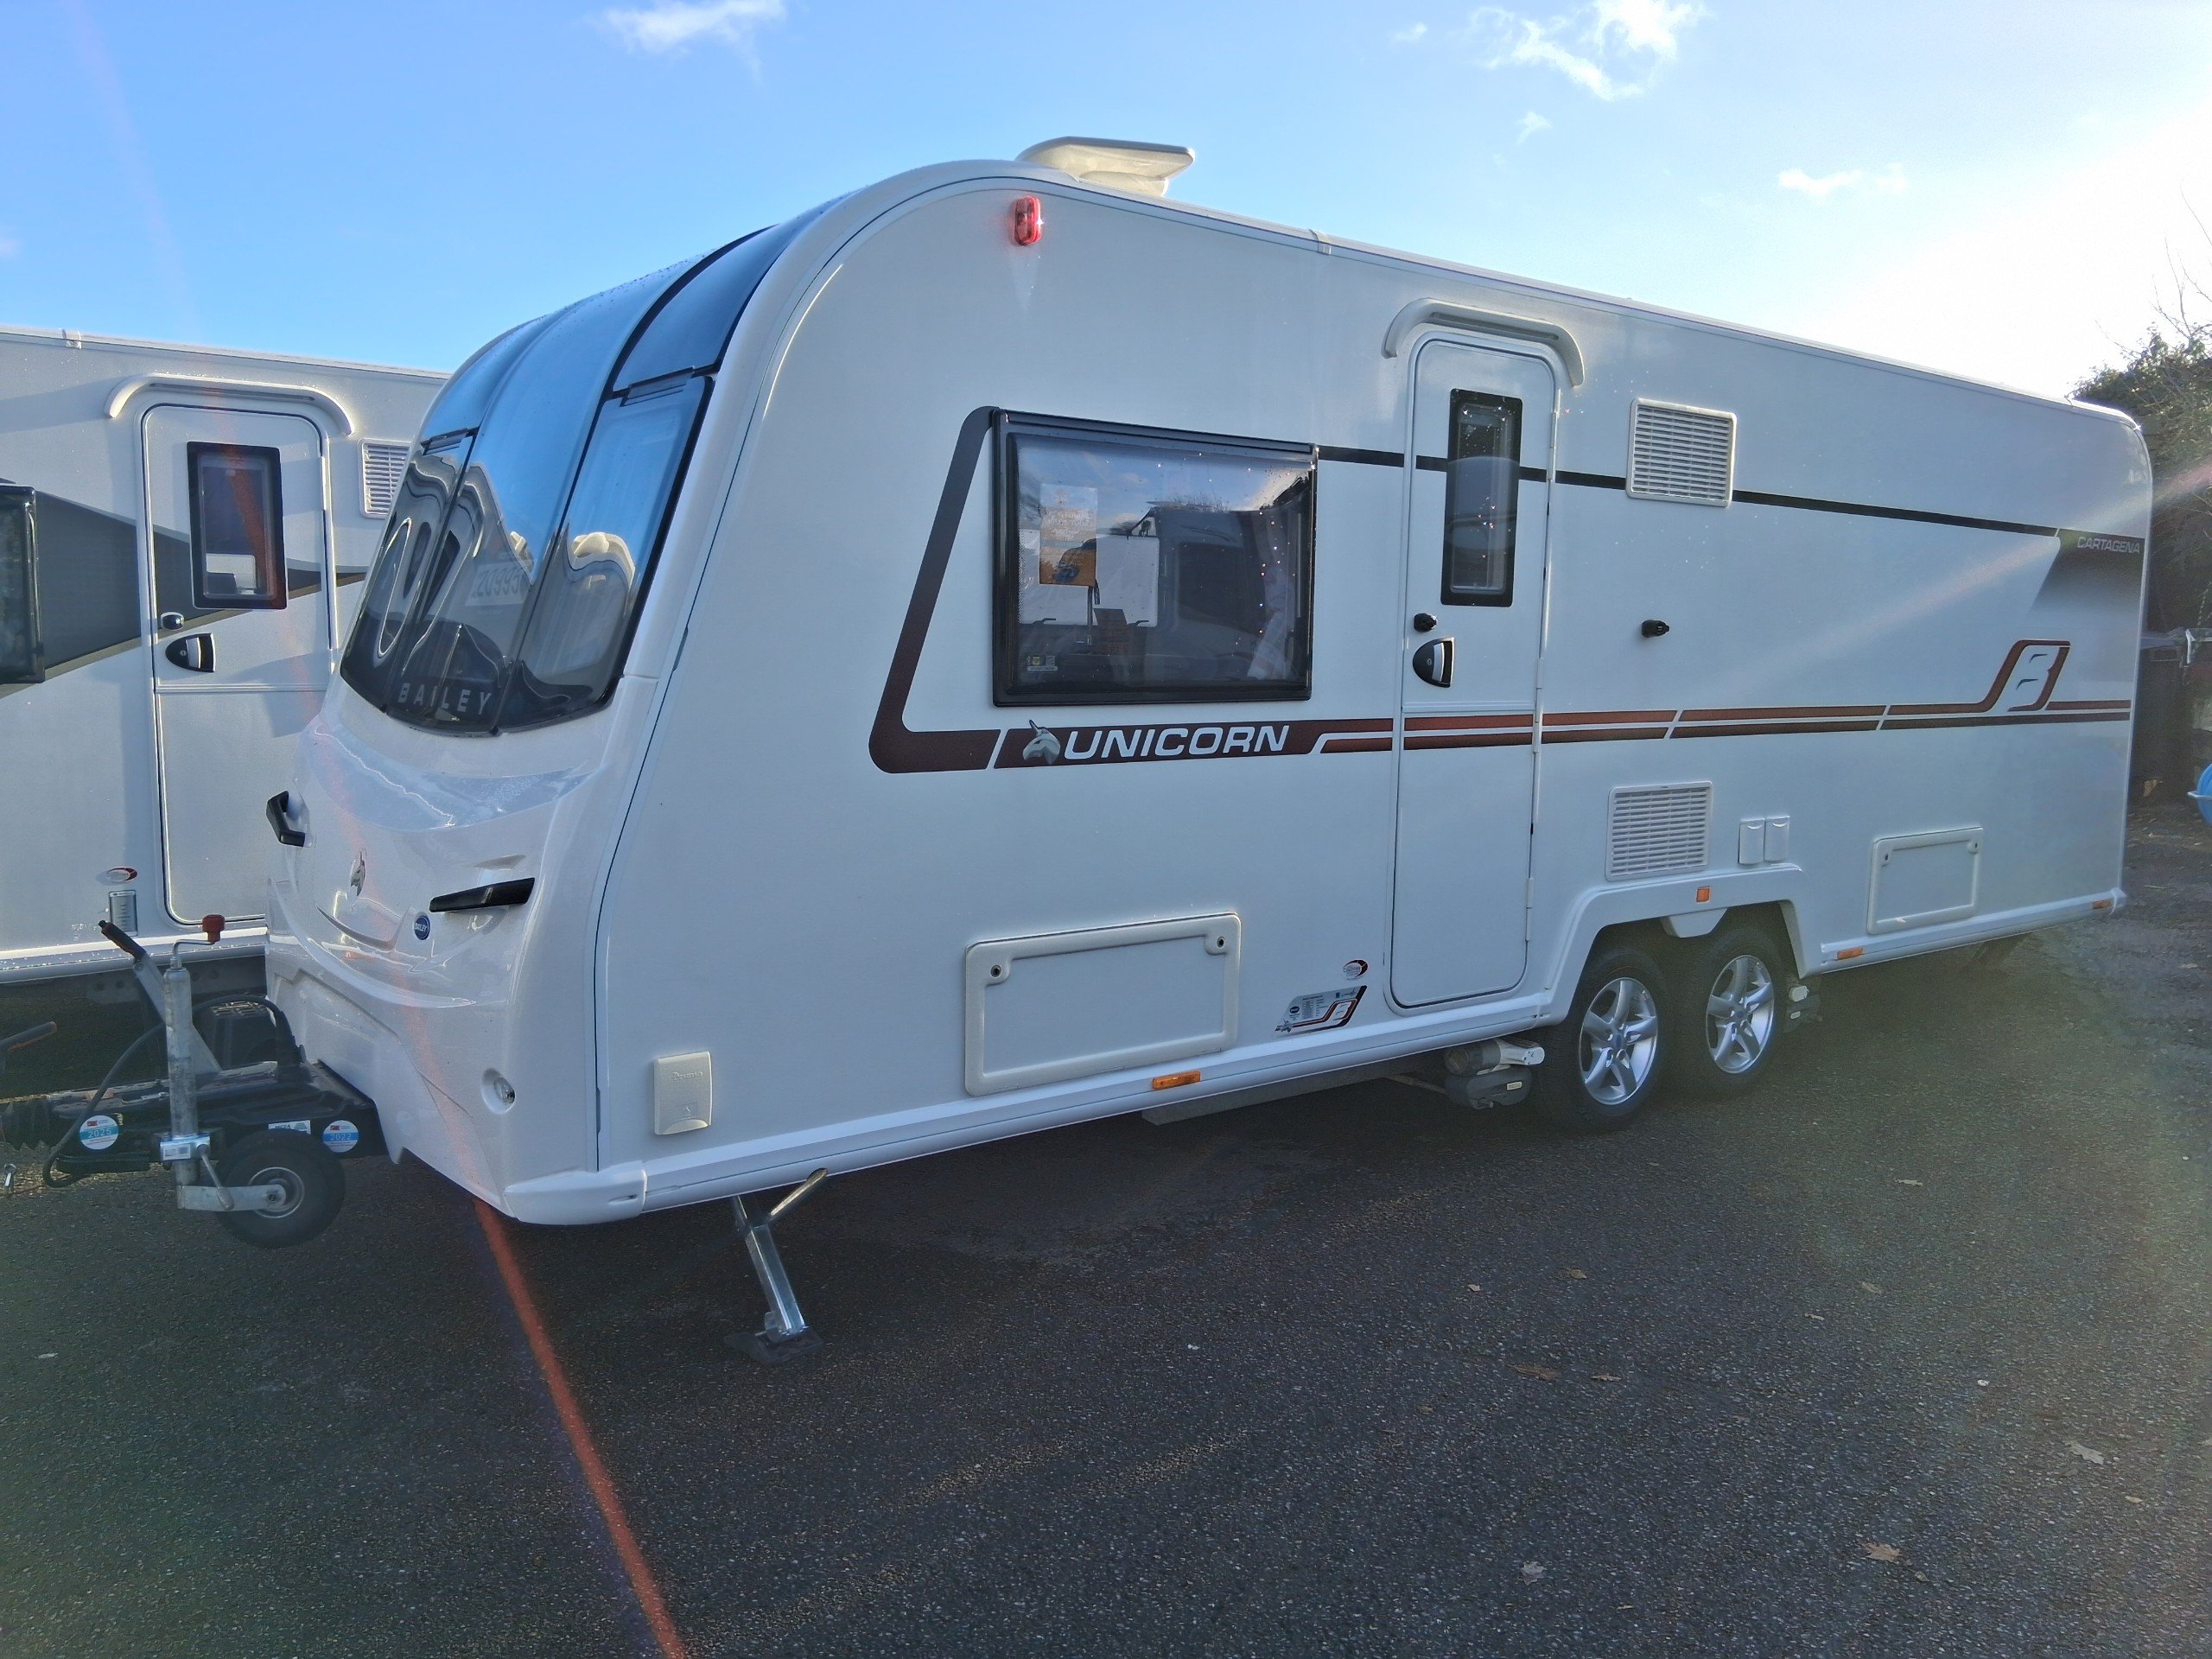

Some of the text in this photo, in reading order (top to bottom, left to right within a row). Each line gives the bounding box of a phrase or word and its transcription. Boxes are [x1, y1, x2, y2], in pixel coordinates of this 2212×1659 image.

[2077, 536, 2141, 554] CARTAGENA
[397, 682, 492, 715] BAILEY
[1064, 724, 1290, 760] UNICORN
[88, 1128, 111, 1139] 2025
